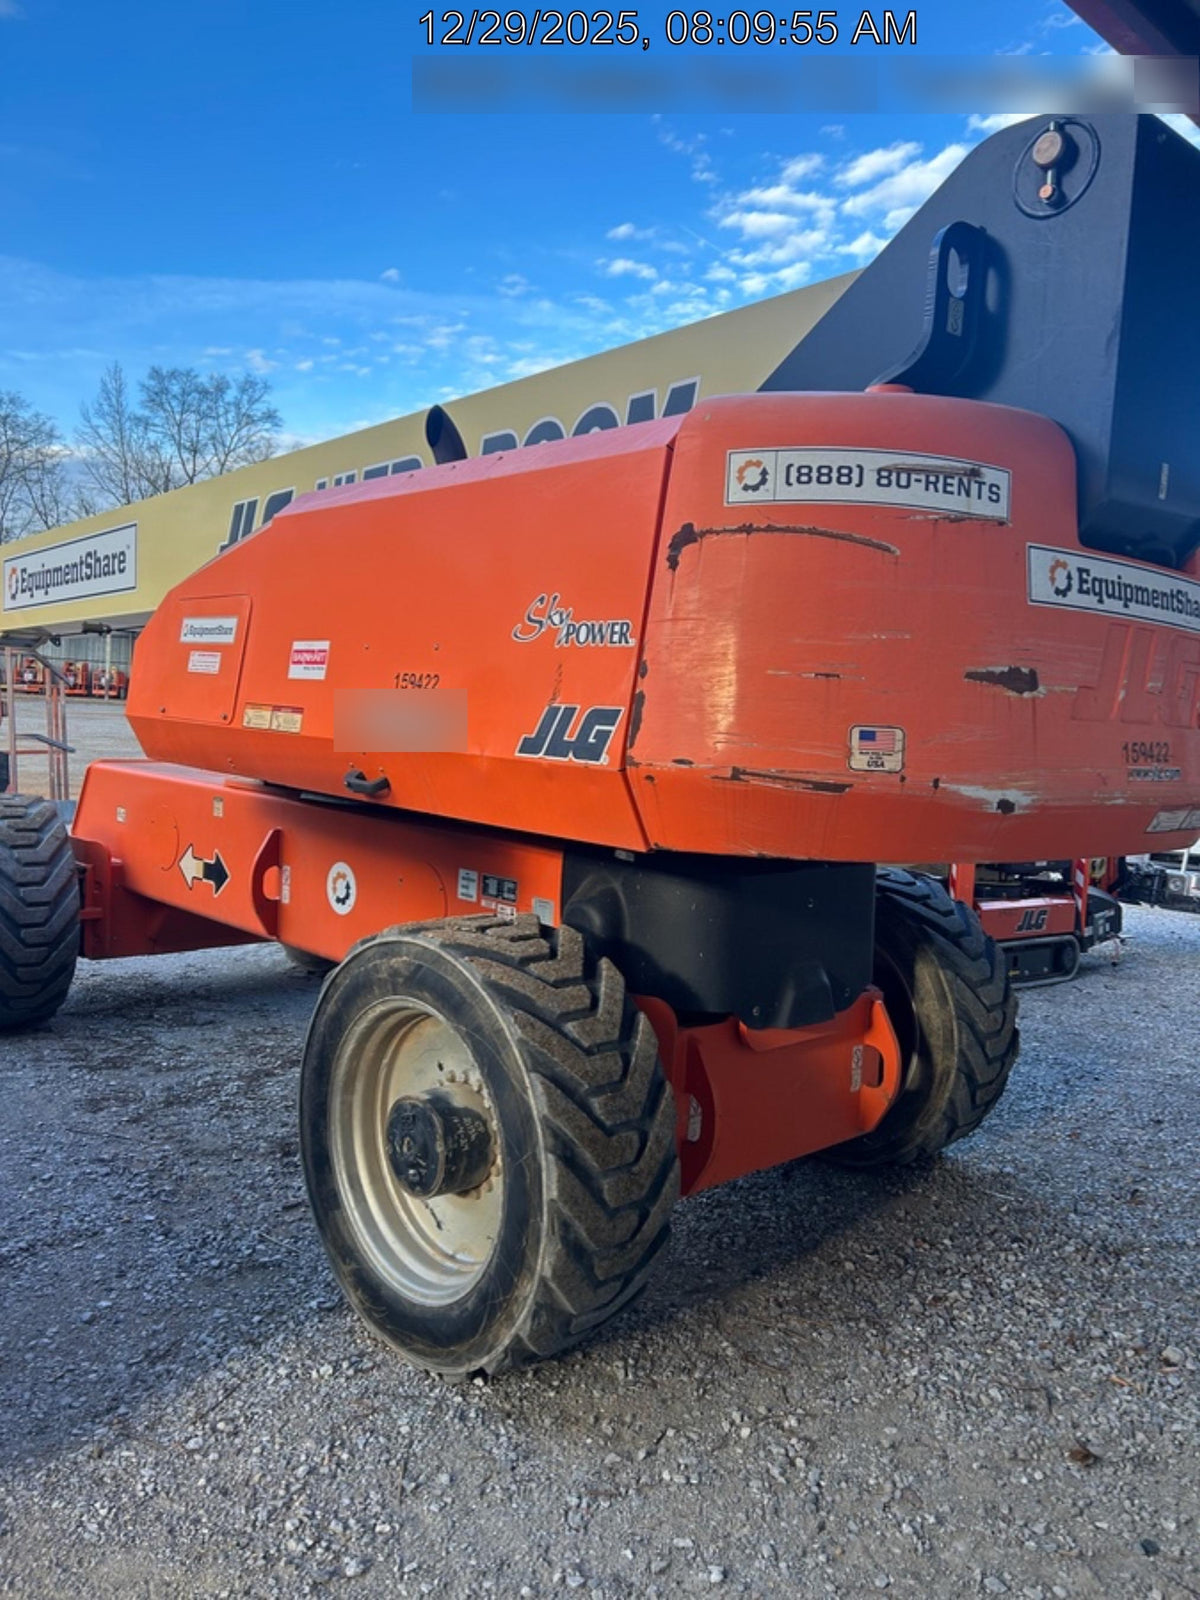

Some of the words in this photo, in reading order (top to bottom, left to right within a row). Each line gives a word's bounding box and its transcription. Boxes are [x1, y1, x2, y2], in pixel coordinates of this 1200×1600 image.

[785, 463, 864, 487] (888)
[876, 464, 1001, 504] 80-RENTS
[20, 549, 127, 598] EquipmentShare
[511, 592, 572, 647] Sky
[561, 619, 632, 646] POWER
[394, 672, 440, 689] 159422
[515, 704, 625, 764] JLG
[1122, 741, 1171, 764] 159422
[1015, 909, 1049, 933] JLG
